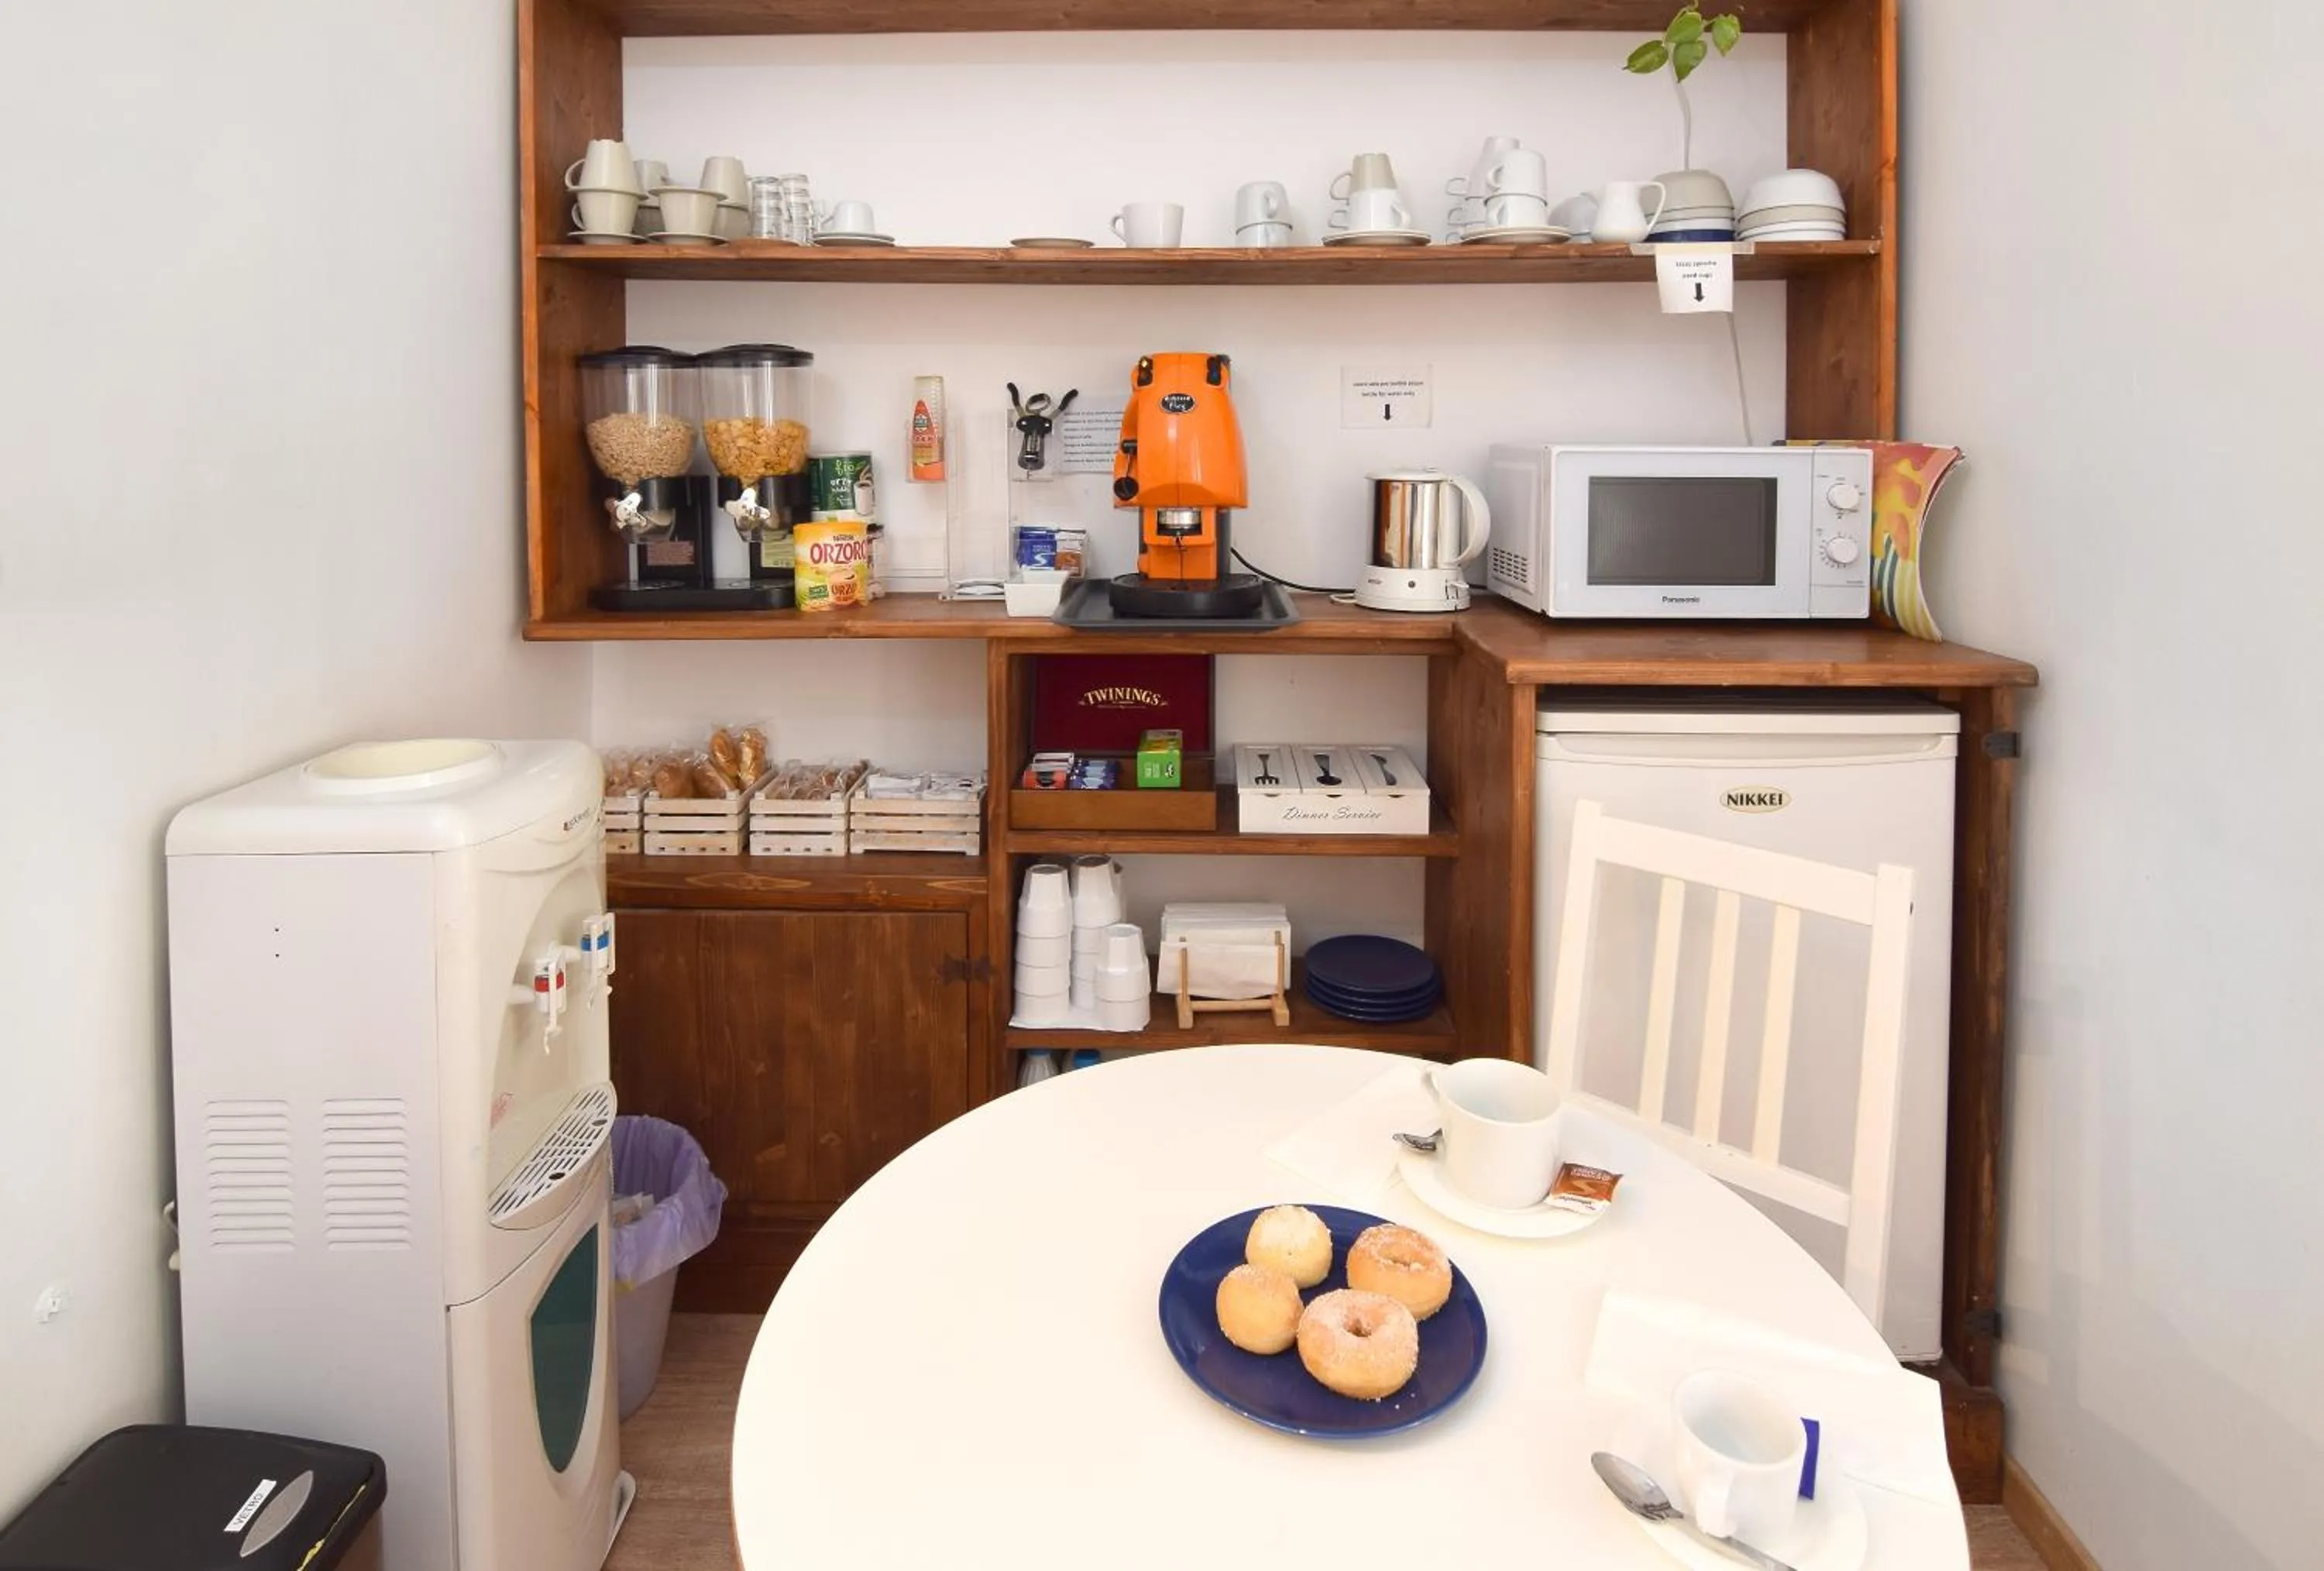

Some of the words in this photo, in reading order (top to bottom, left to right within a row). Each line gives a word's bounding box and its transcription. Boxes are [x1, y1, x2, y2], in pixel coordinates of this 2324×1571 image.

[1662, 596, 1700, 604] Panasonic
[1084, 686, 1162, 706] TWININGS
[1726, 792, 1783, 806] NIKKEI
[1282, 806, 1329, 821] Dinner
[1332, 806, 1382, 823] Service
[232, 1492, 263, 1525] VETRO
